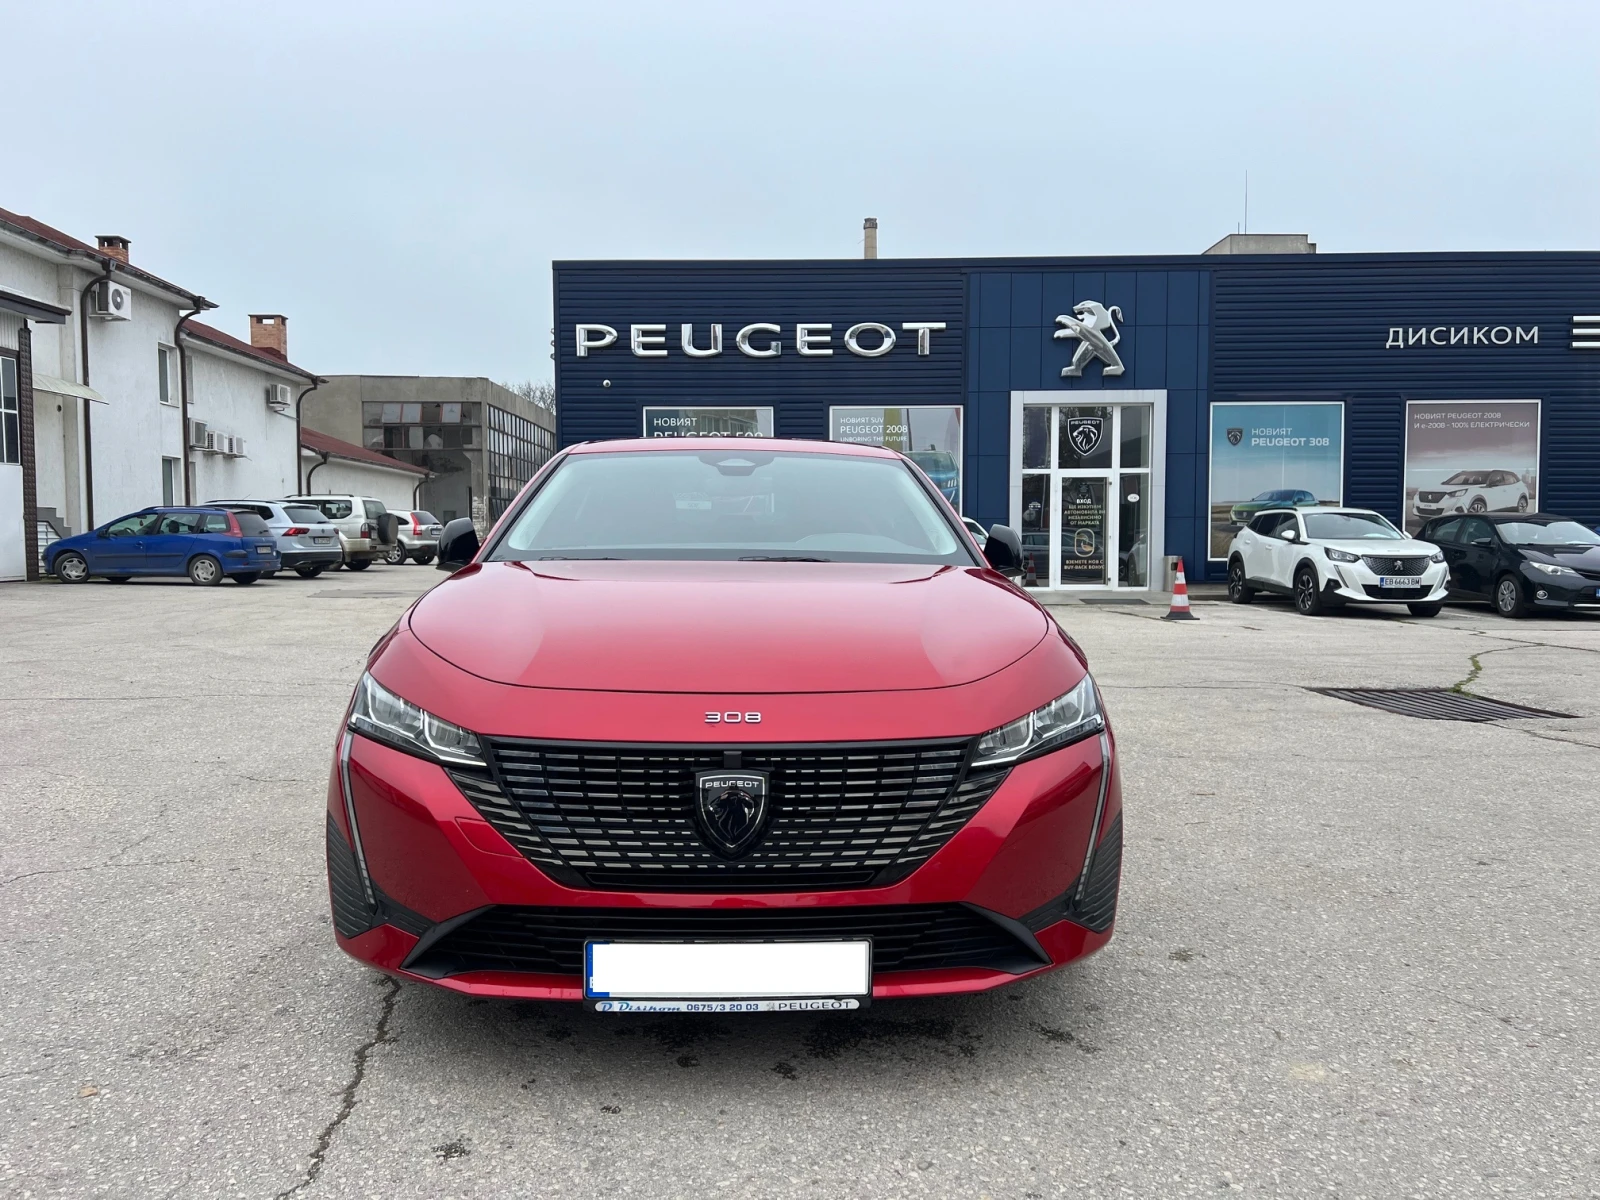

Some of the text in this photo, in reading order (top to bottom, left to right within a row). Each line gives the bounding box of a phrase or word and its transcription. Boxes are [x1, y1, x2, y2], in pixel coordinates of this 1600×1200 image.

[575, 321, 947, 358] PEUGEOT
[1386, 326, 1539, 349] ДИСИКОМ
[654, 417, 698, 426] НОВИЯТ
[840, 425, 908, 434] PEUGEOT 2008
[1252, 428, 1292, 436] НОВИЯТ
[1252, 438, 1329, 446] PEUGEOT 308
[704, 711, 761, 723] 308
[686, 1003, 726, 1012] 0675/3
[778, 1002, 852, 1010] PEUGEOT
